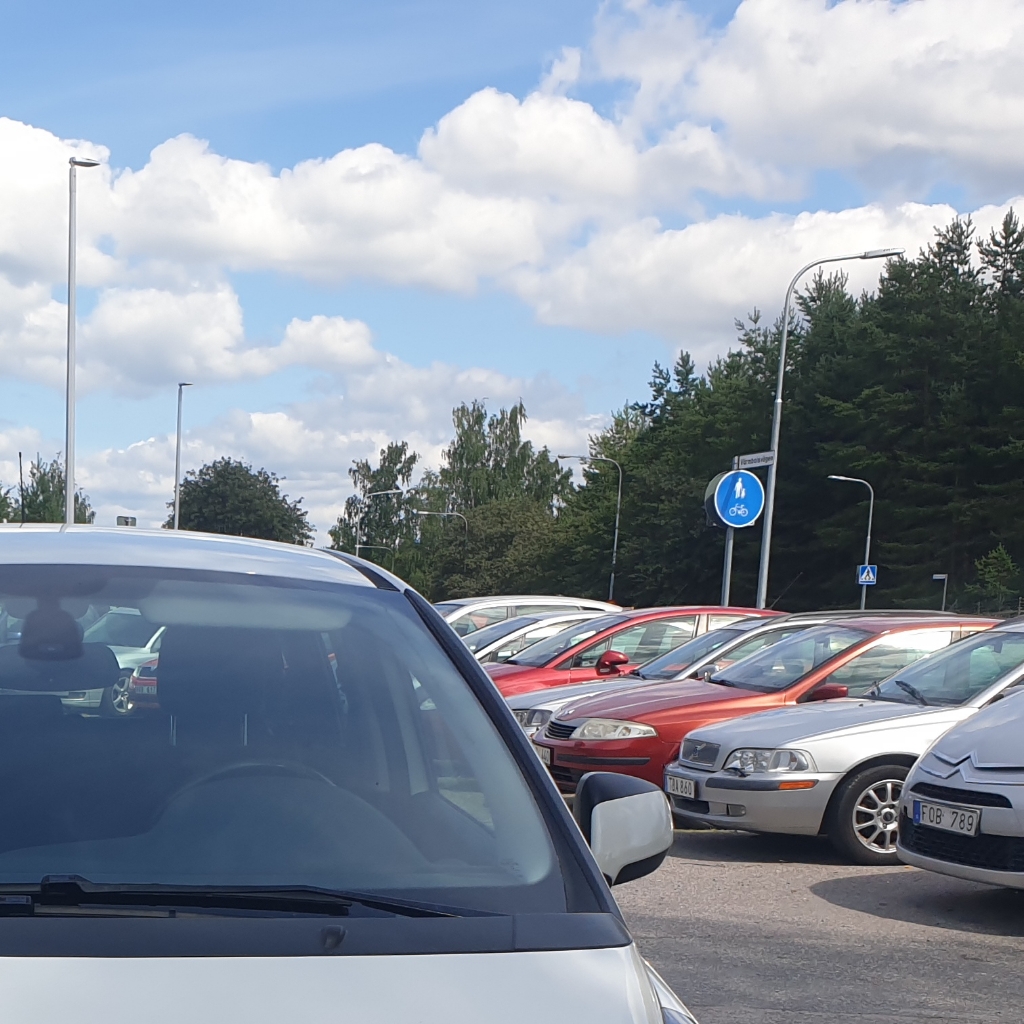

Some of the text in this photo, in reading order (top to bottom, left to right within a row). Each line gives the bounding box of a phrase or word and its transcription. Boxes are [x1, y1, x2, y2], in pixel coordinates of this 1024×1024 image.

[680, 780, 693, 796] 860
[921, 804, 974, 832] FOB 789
